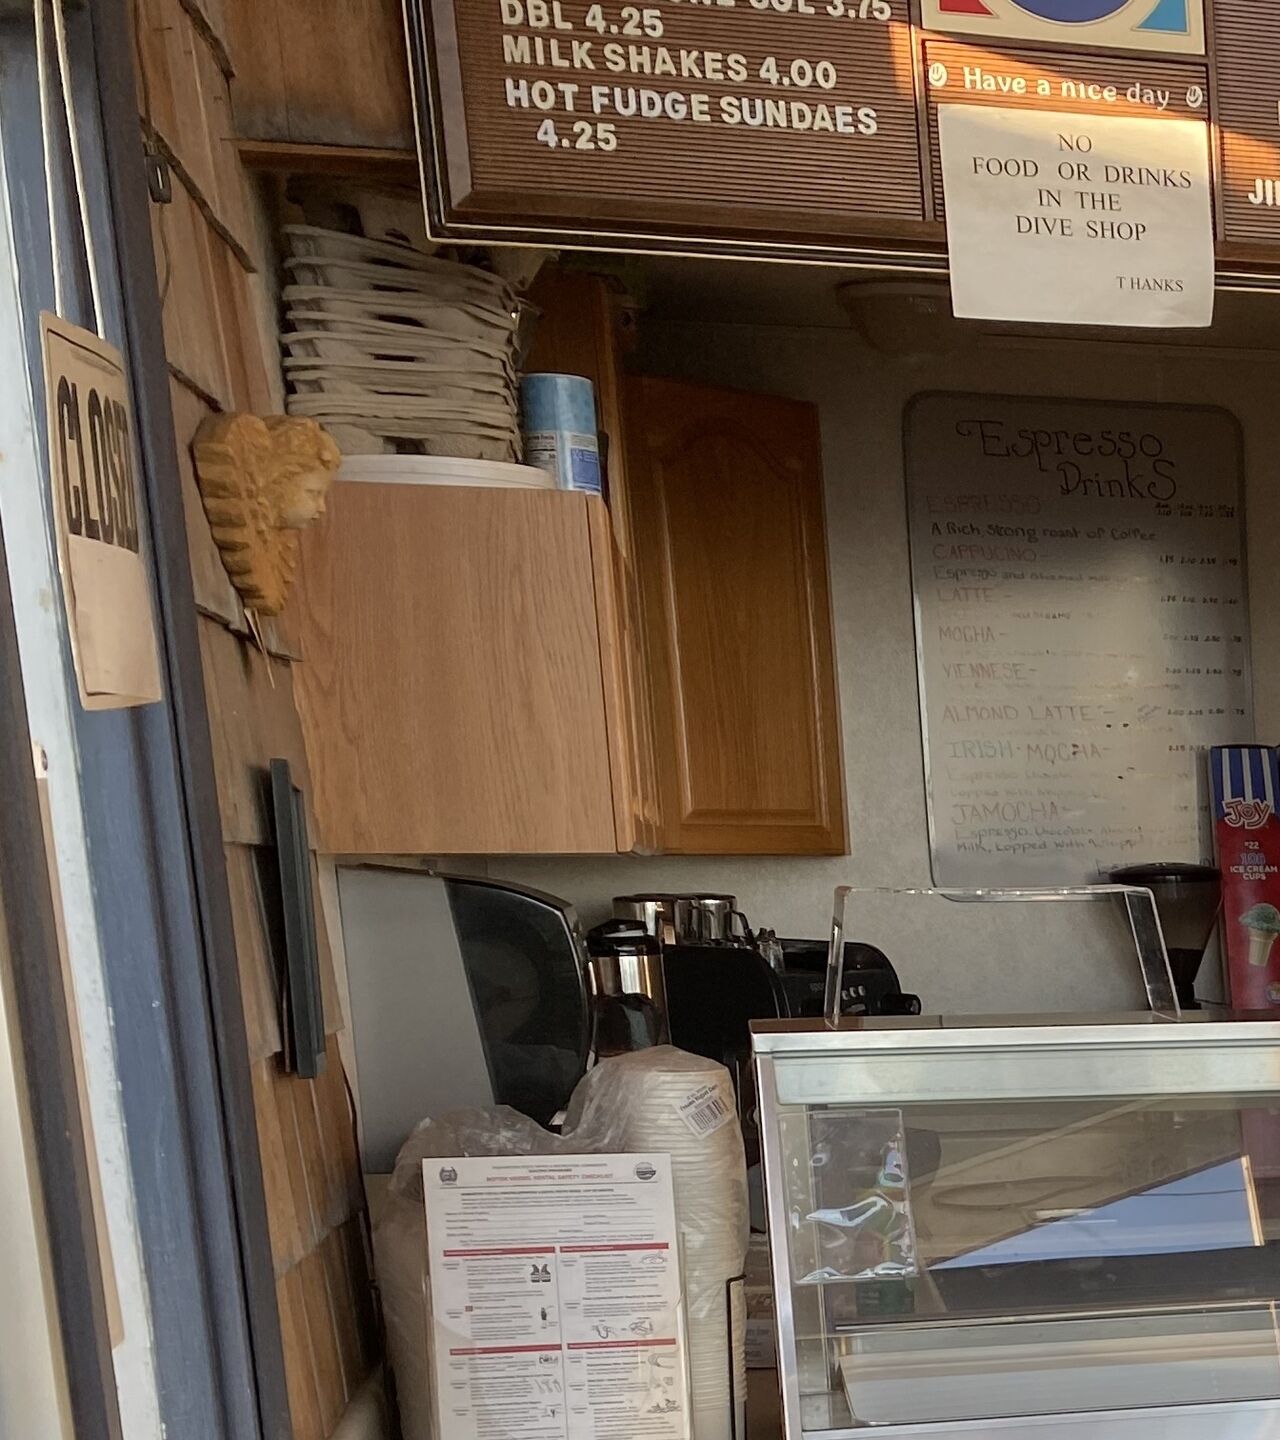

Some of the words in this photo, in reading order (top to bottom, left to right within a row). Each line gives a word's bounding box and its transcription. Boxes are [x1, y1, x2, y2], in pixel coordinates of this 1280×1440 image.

[501, 0, 573, 30] DBL
[585, 4, 664, 37] 4.25
[502, 34, 596, 70] MILK
[603, 43, 748, 82] SHAKES
[759, 56, 838, 90] 4.00
[963, 65, 1027, 95] Have
[1036, 78, 1051, 97] a
[1061, 80, 1117, 102] nice
[1126, 82, 1170, 111] day
[505, 78, 580, 111] HOT
[591, 84, 711, 122] FUDGE
[719, 95, 878, 136] SUNDAES
[536, 118, 618, 151] 4.25
[1057, 133, 1093, 153] NO
[972, 157, 1039, 178] FOOD
[1057, 161, 1093, 182] OR
[1104, 165, 1192, 189] DRINKS
[1037, 188, 1062, 207] IN
[1075, 191, 1122, 212] THE
[1016, 215, 1074, 237] DIVE
[1086, 220, 1147, 241] SHOP
[956, 420, 1164, 472] Espresso
[942, 704, 1019, 723] ALMOND
[1229, 864, 1246, 873] ICE
[1247, 864, 1279, 874] CREAM
[1241, 873, 1266, 881] CUPS
